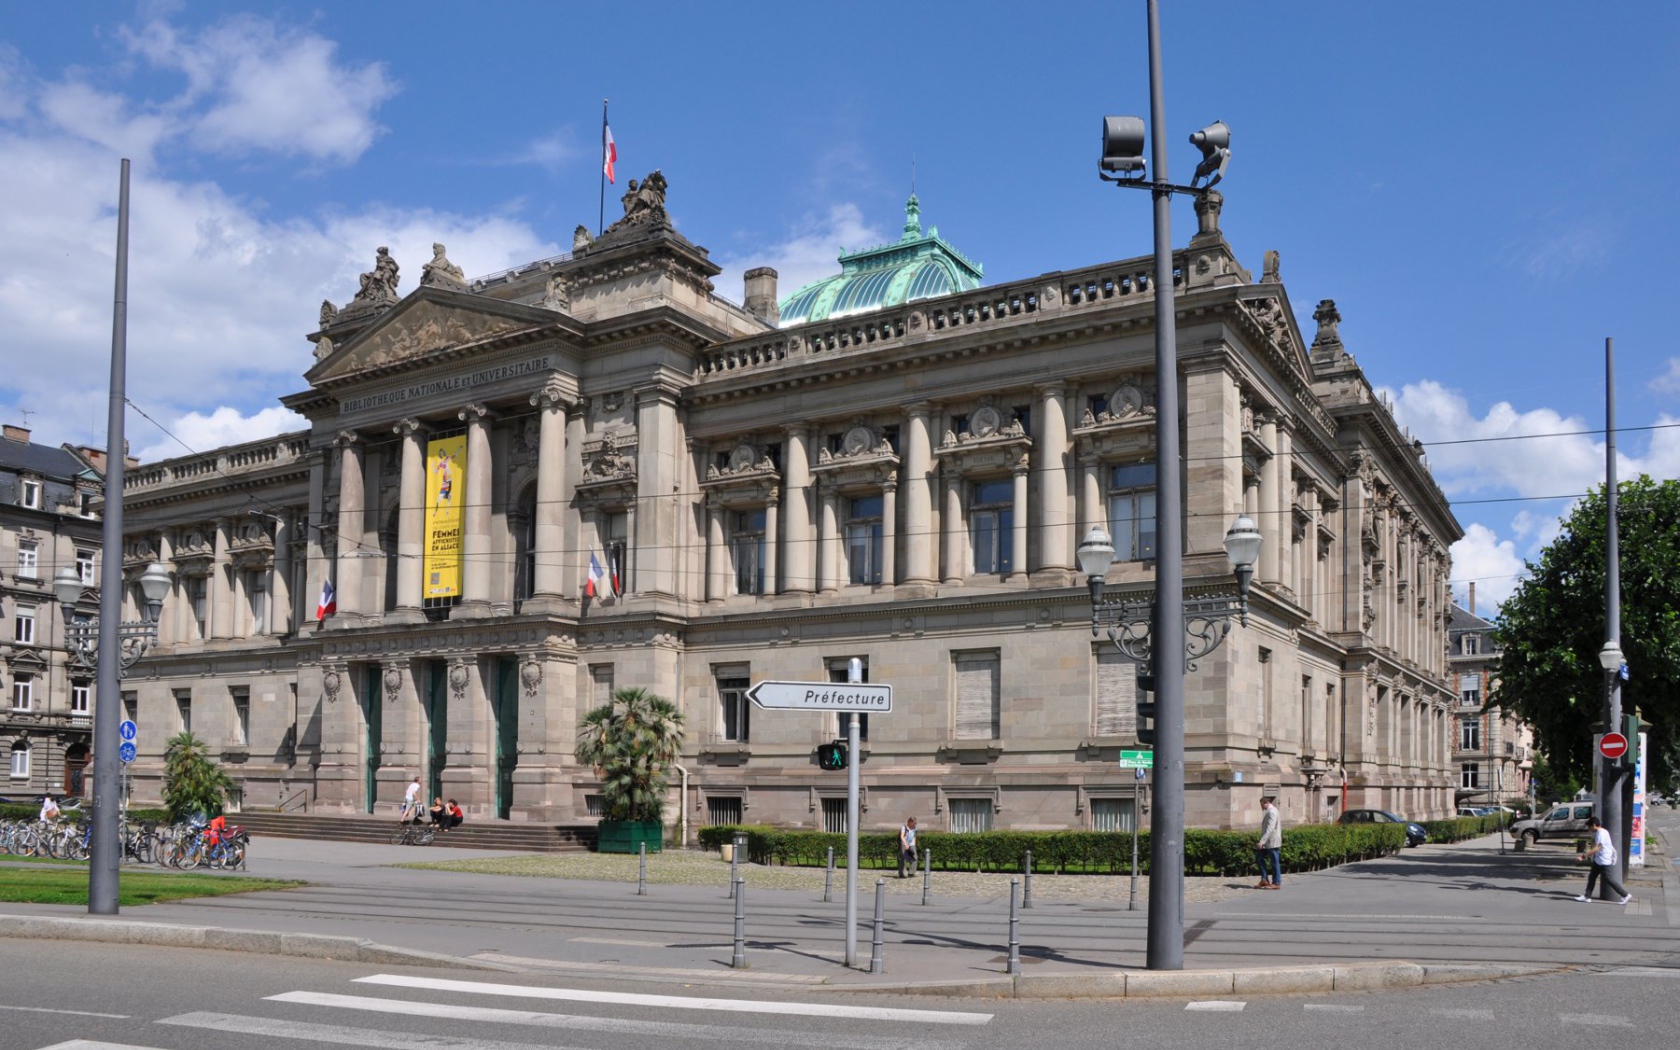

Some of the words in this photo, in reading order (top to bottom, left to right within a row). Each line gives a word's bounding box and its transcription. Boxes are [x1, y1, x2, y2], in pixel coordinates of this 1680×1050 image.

[344, 389, 406, 412] BIBLIOTHEQUE
[408, 378, 460, 398] NATIONALE
[472, 357, 549, 384] UNIVERSITAIRE
[432, 528, 460, 539] FEMMES
[804, 690, 885, 705] Préfecture
